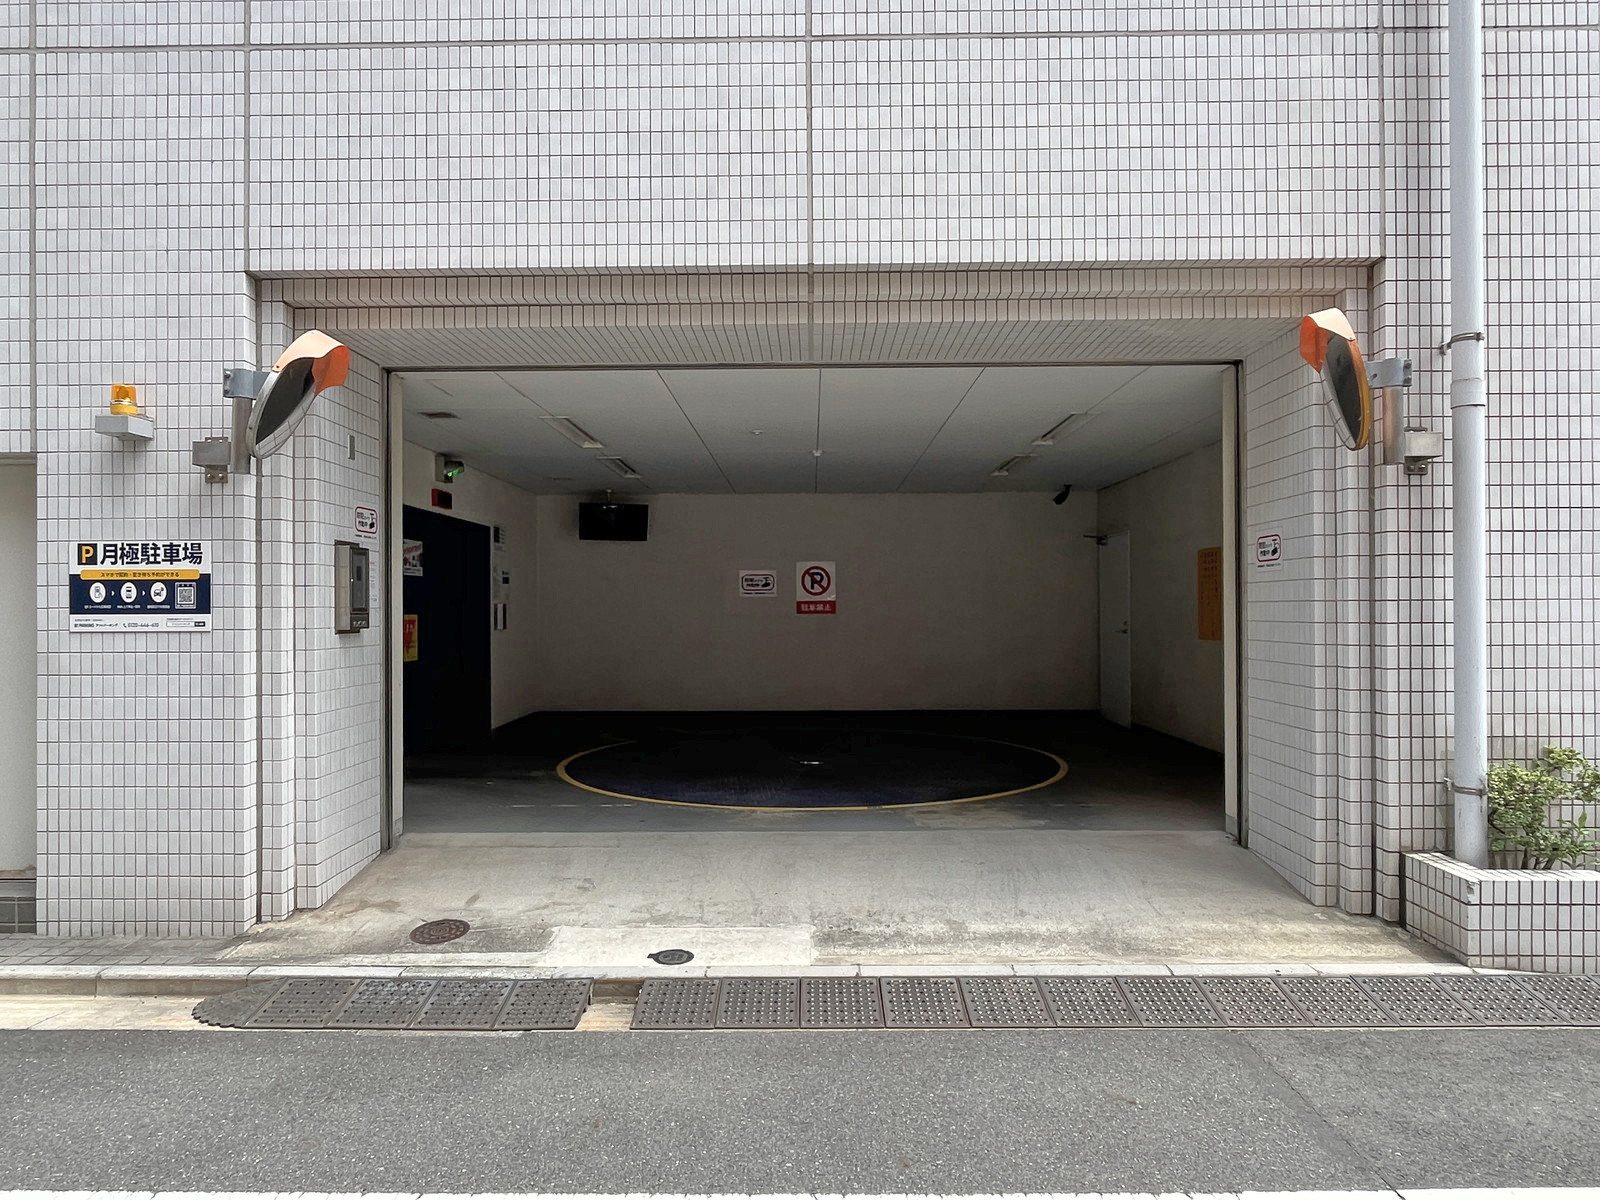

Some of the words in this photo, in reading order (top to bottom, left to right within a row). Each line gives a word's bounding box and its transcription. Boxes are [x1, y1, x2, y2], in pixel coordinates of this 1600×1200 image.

[81, 545, 94, 564] P
[100, 542, 203, 565] 月極駐車場
